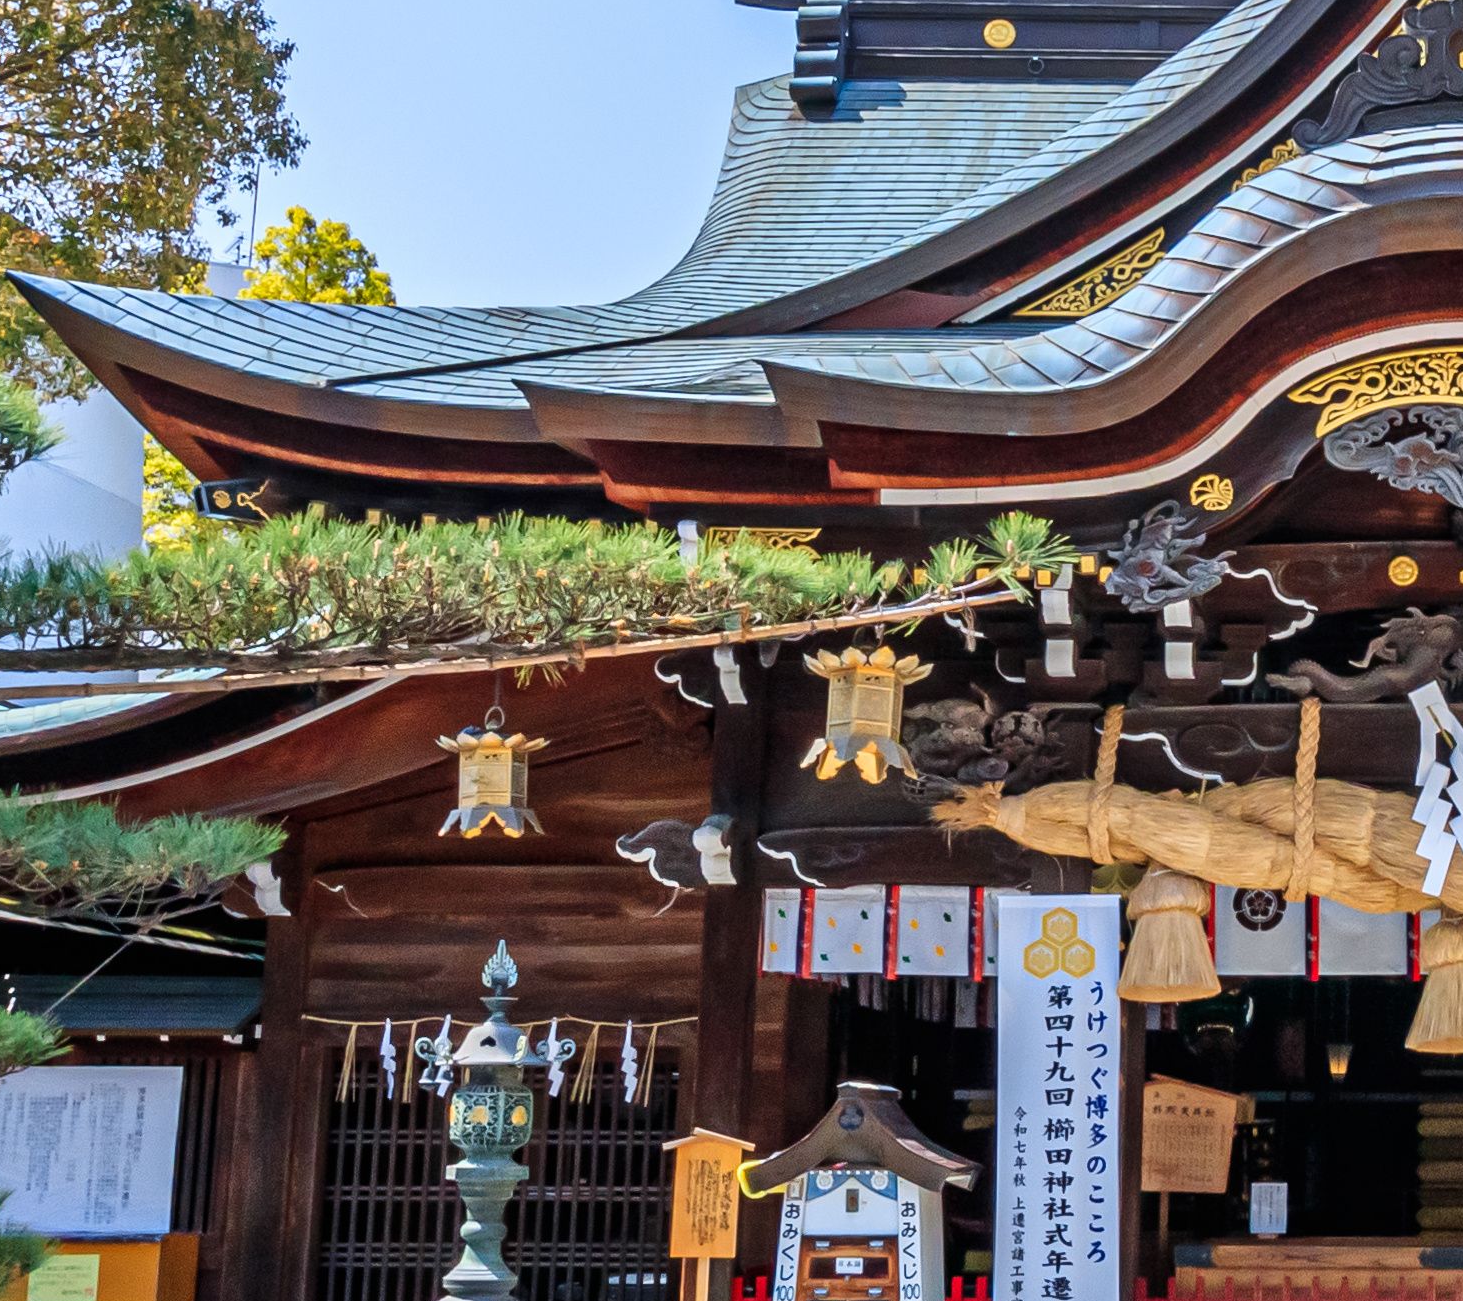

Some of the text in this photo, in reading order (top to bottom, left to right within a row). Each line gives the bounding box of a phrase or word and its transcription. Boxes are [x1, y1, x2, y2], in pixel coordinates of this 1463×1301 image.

[1044, 985, 1075, 1107] 第四十九回
[1013, 1105, 1028, 1188] 令和七年秋
[1085, 981, 1109, 1263] うけつぐ博多のこころ
